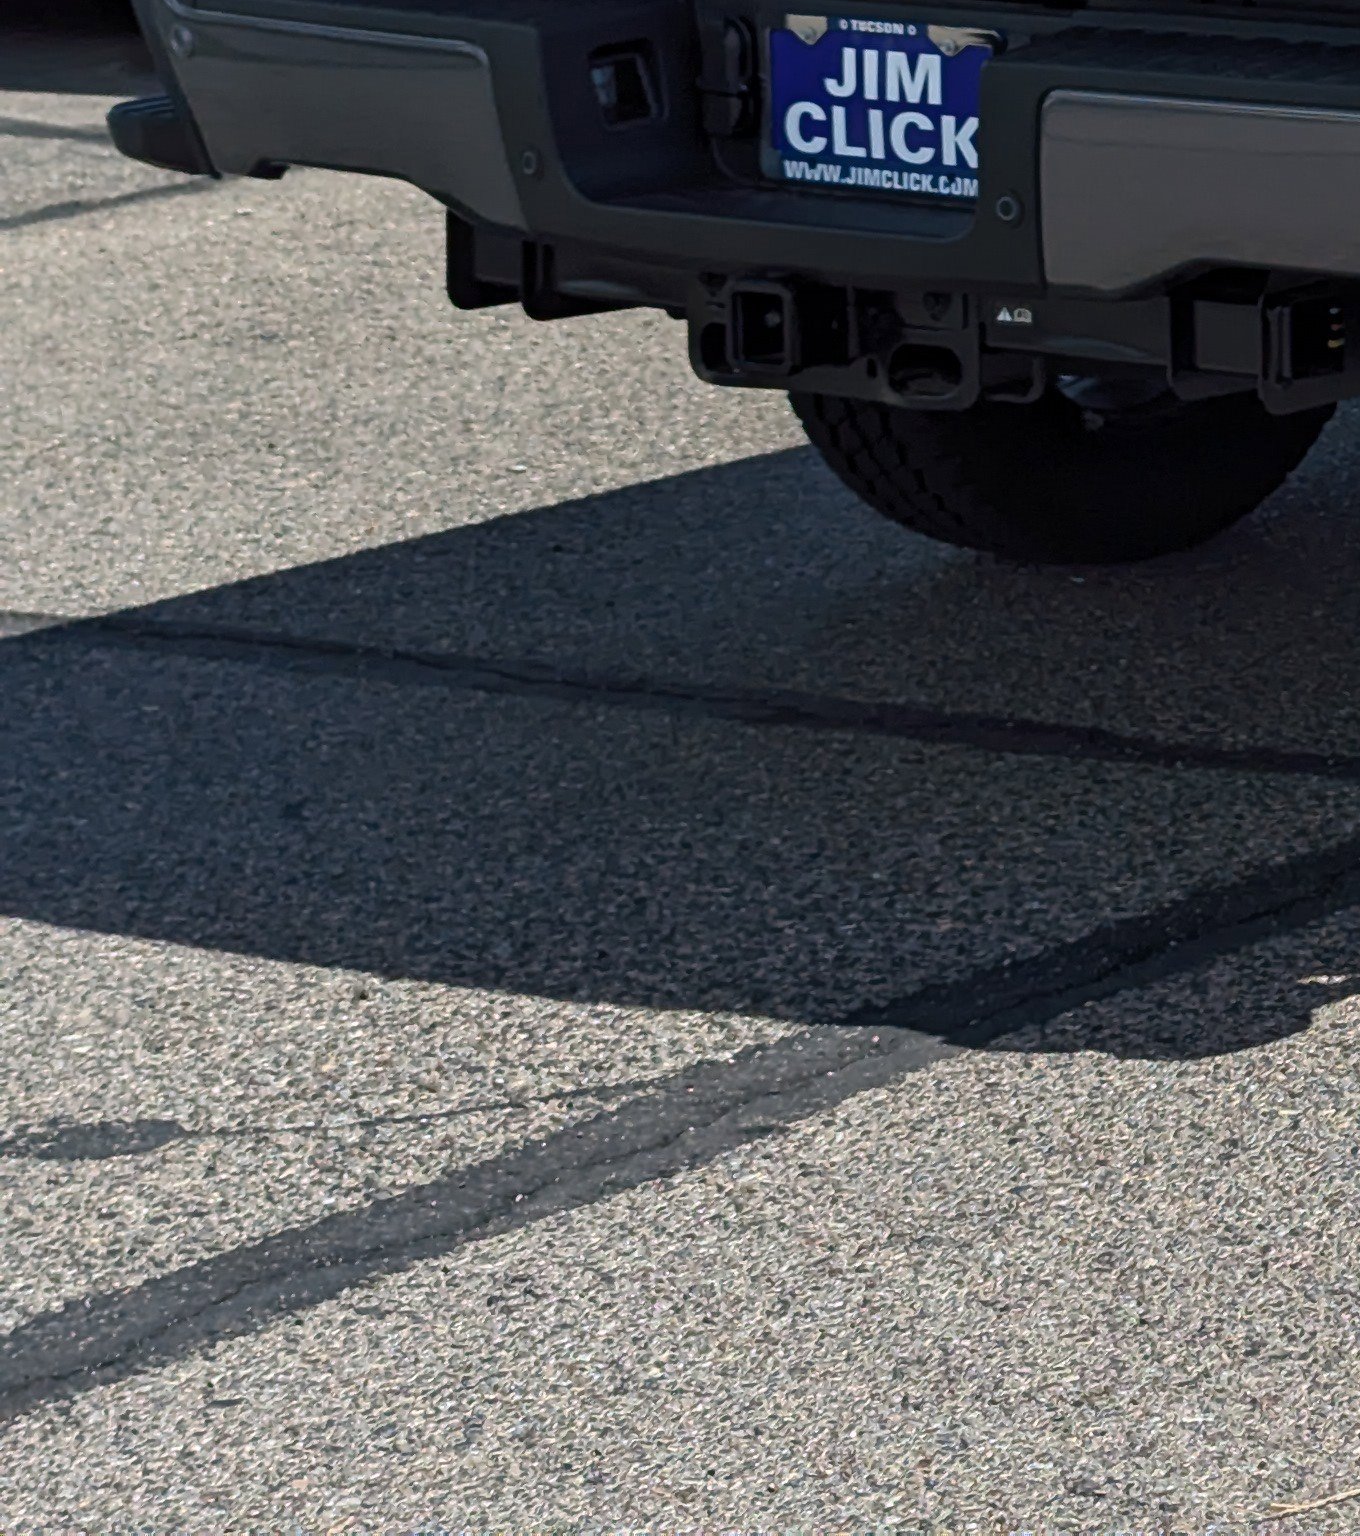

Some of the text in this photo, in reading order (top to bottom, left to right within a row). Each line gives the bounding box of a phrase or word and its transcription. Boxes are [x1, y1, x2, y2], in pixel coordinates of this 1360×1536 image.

[850, 18, 905, 36] TUCSON
[823, 46, 942, 106] JIM
[783, 100, 979, 169] CLICK
[782, 158, 979, 198] WWW.JIMCLICK.COM
